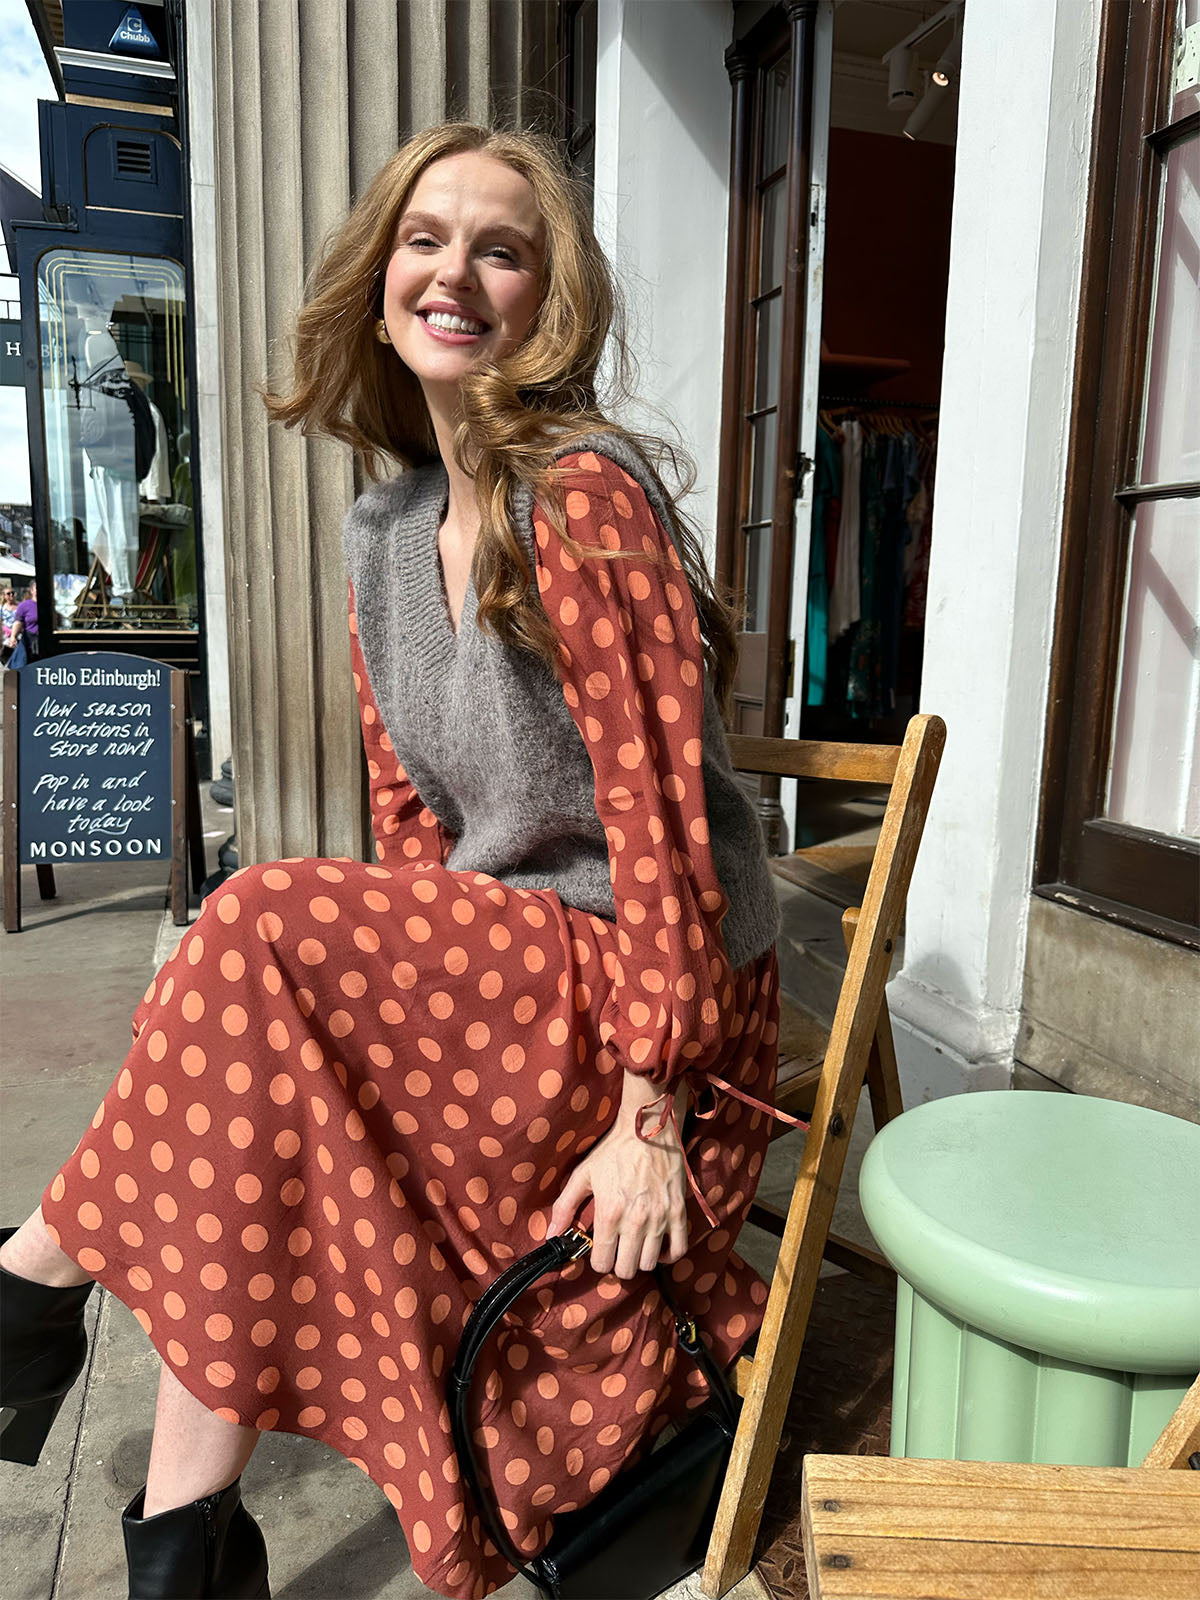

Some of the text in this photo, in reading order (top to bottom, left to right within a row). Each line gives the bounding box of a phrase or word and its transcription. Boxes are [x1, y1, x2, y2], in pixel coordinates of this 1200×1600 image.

[120, 30, 151, 43] Chubb
[36, 667, 161, 691] Hello Edinburgh!
[36, 696, 152, 718] New season
[134, 721, 150, 738] in
[71, 773, 90, 791] in
[101, 770, 147, 790] and
[41, 793, 155, 813] have a look
[67, 812, 133, 836] today
[30, 838, 162, 858] MONSOON
